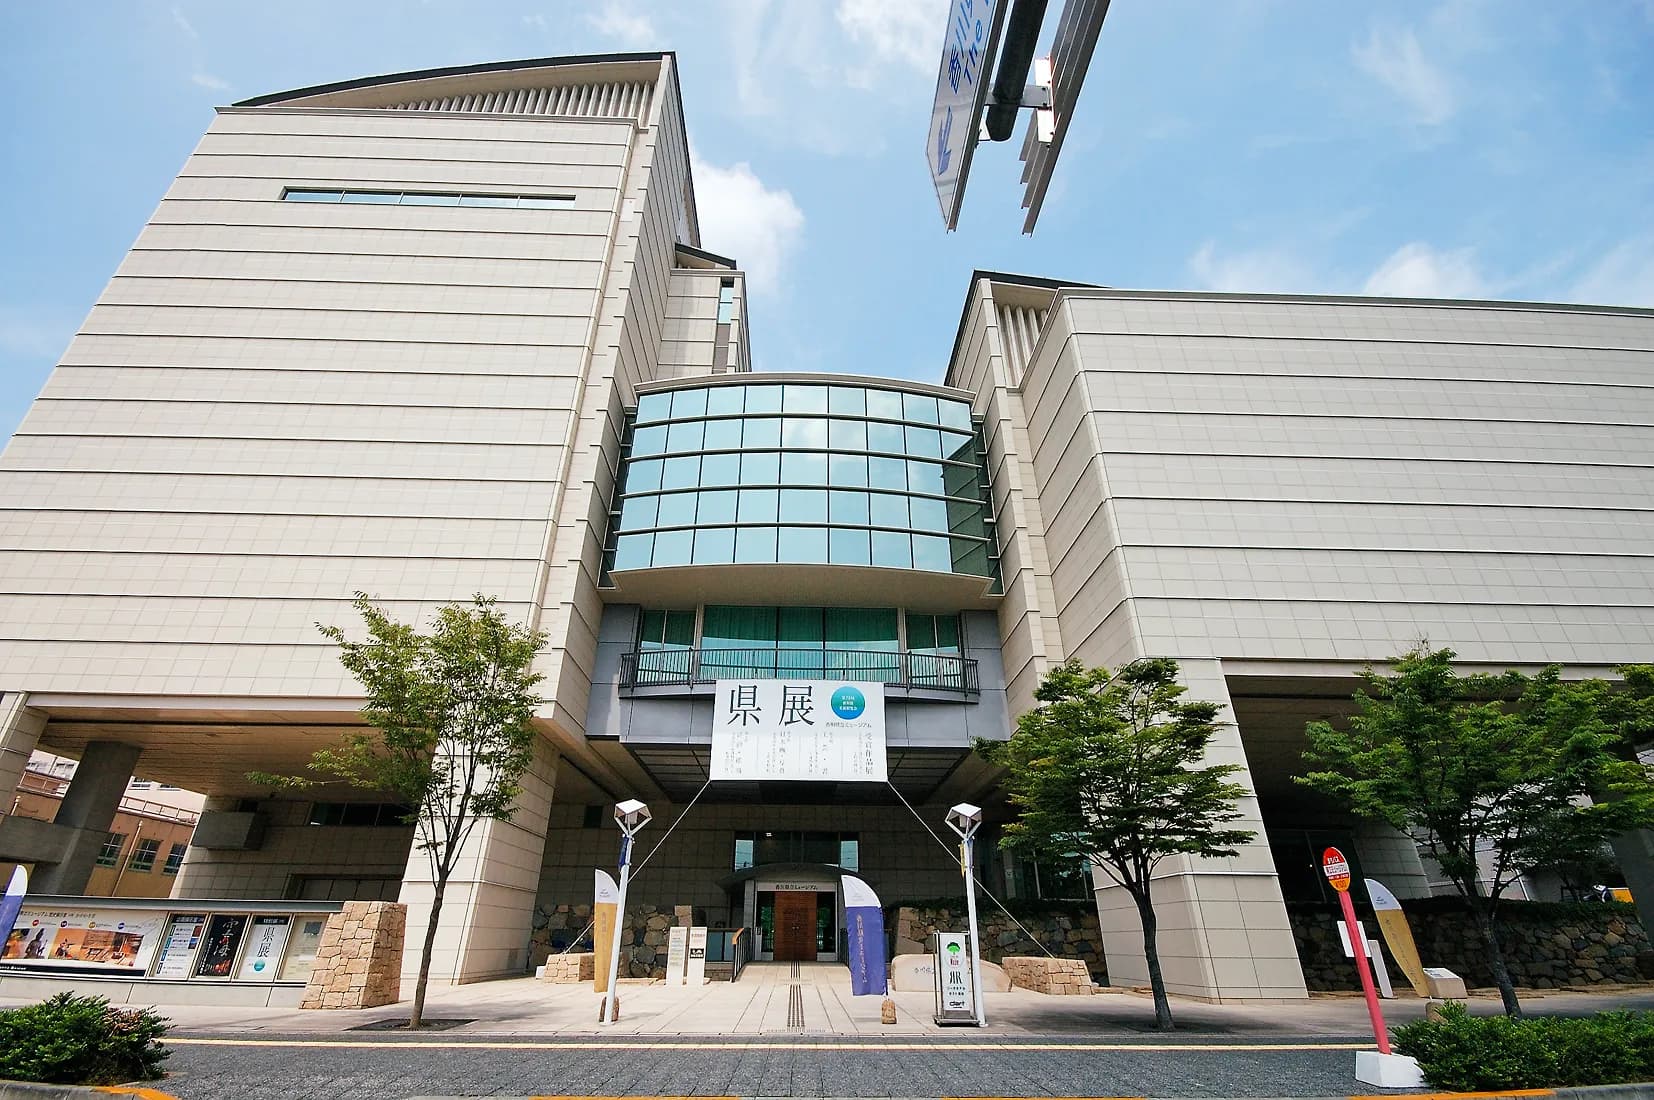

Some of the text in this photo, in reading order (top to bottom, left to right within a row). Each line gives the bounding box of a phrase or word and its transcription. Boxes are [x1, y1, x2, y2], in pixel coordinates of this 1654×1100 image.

[963, 18, 983, 86] The
[727, 685, 815, 727] 県展
[256, 926, 275, 958] 県展
